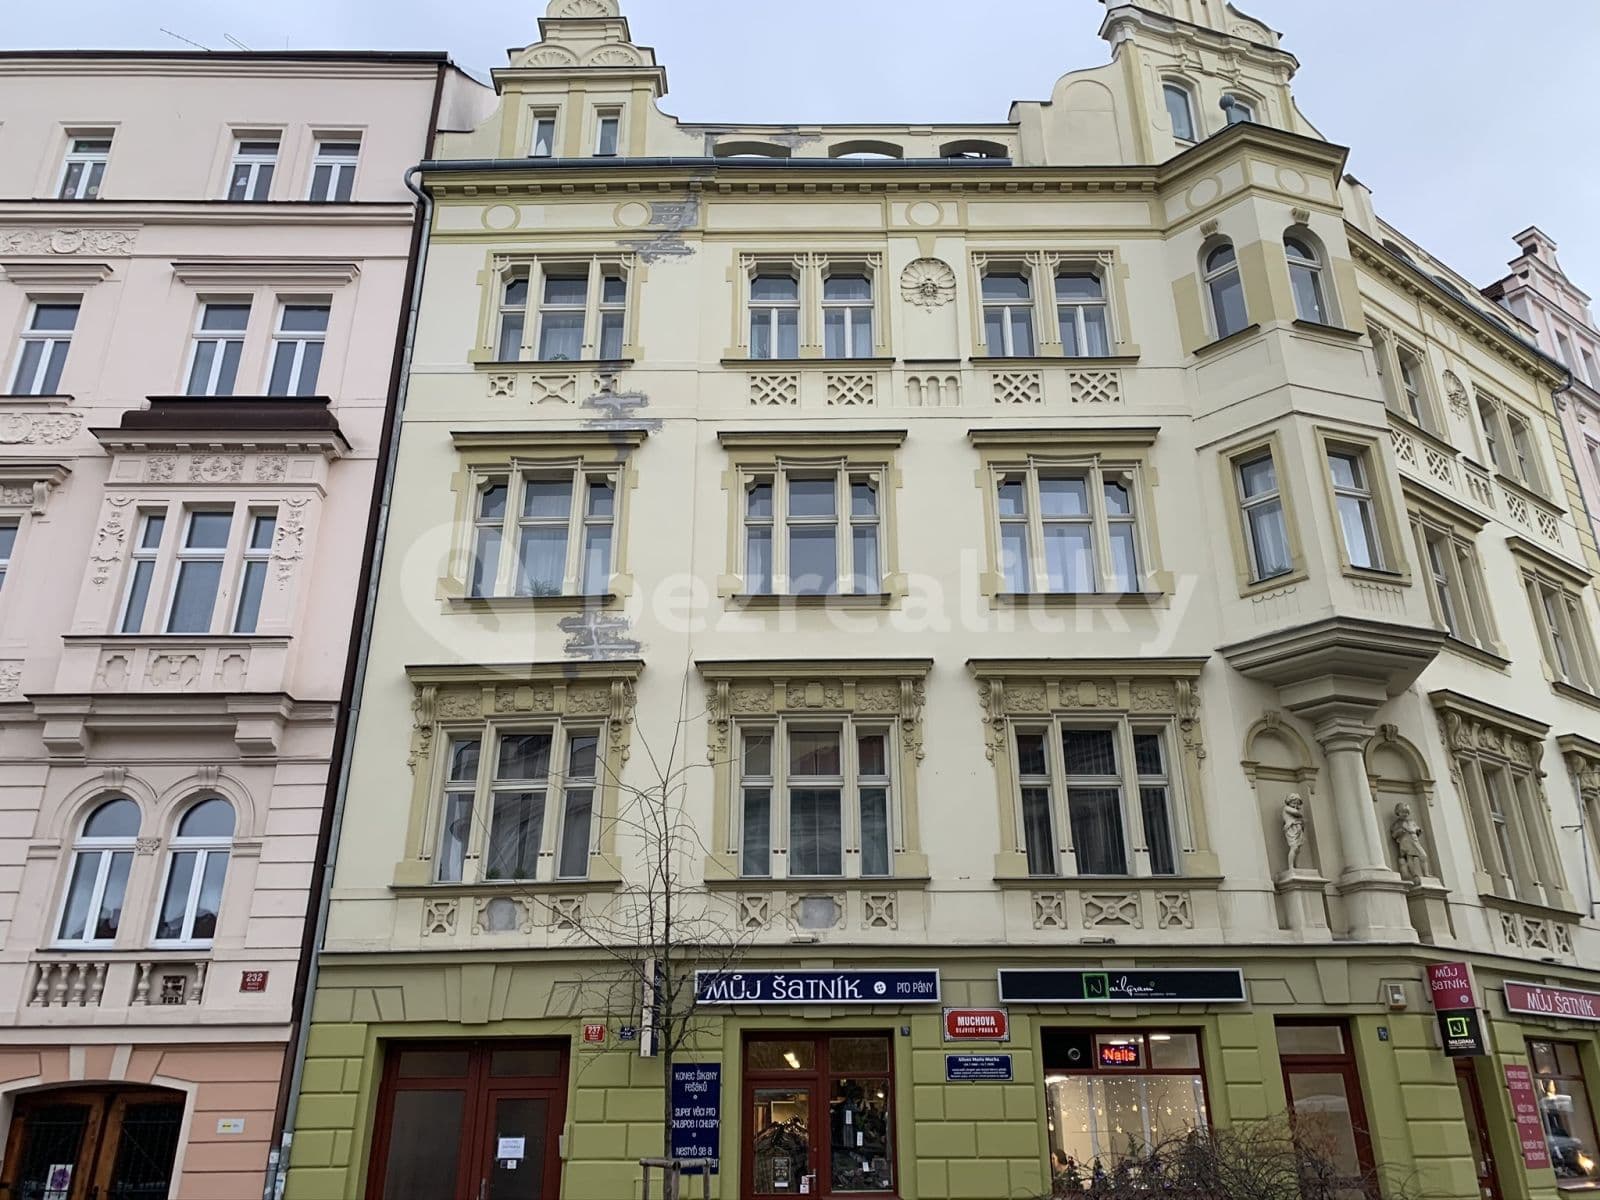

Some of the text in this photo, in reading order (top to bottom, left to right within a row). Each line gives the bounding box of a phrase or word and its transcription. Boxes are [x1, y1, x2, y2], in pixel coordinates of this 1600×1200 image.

[246, 972, 264, 982] 232
[1435, 966, 1458, 978] MŮJ
[705, 974, 762, 999] MŮJ
[1526, 988, 1553, 1011] MŮJ
[957, 1016, 997, 1026] MUCHOVA
[1103, 1048, 1137, 1062] Nails
